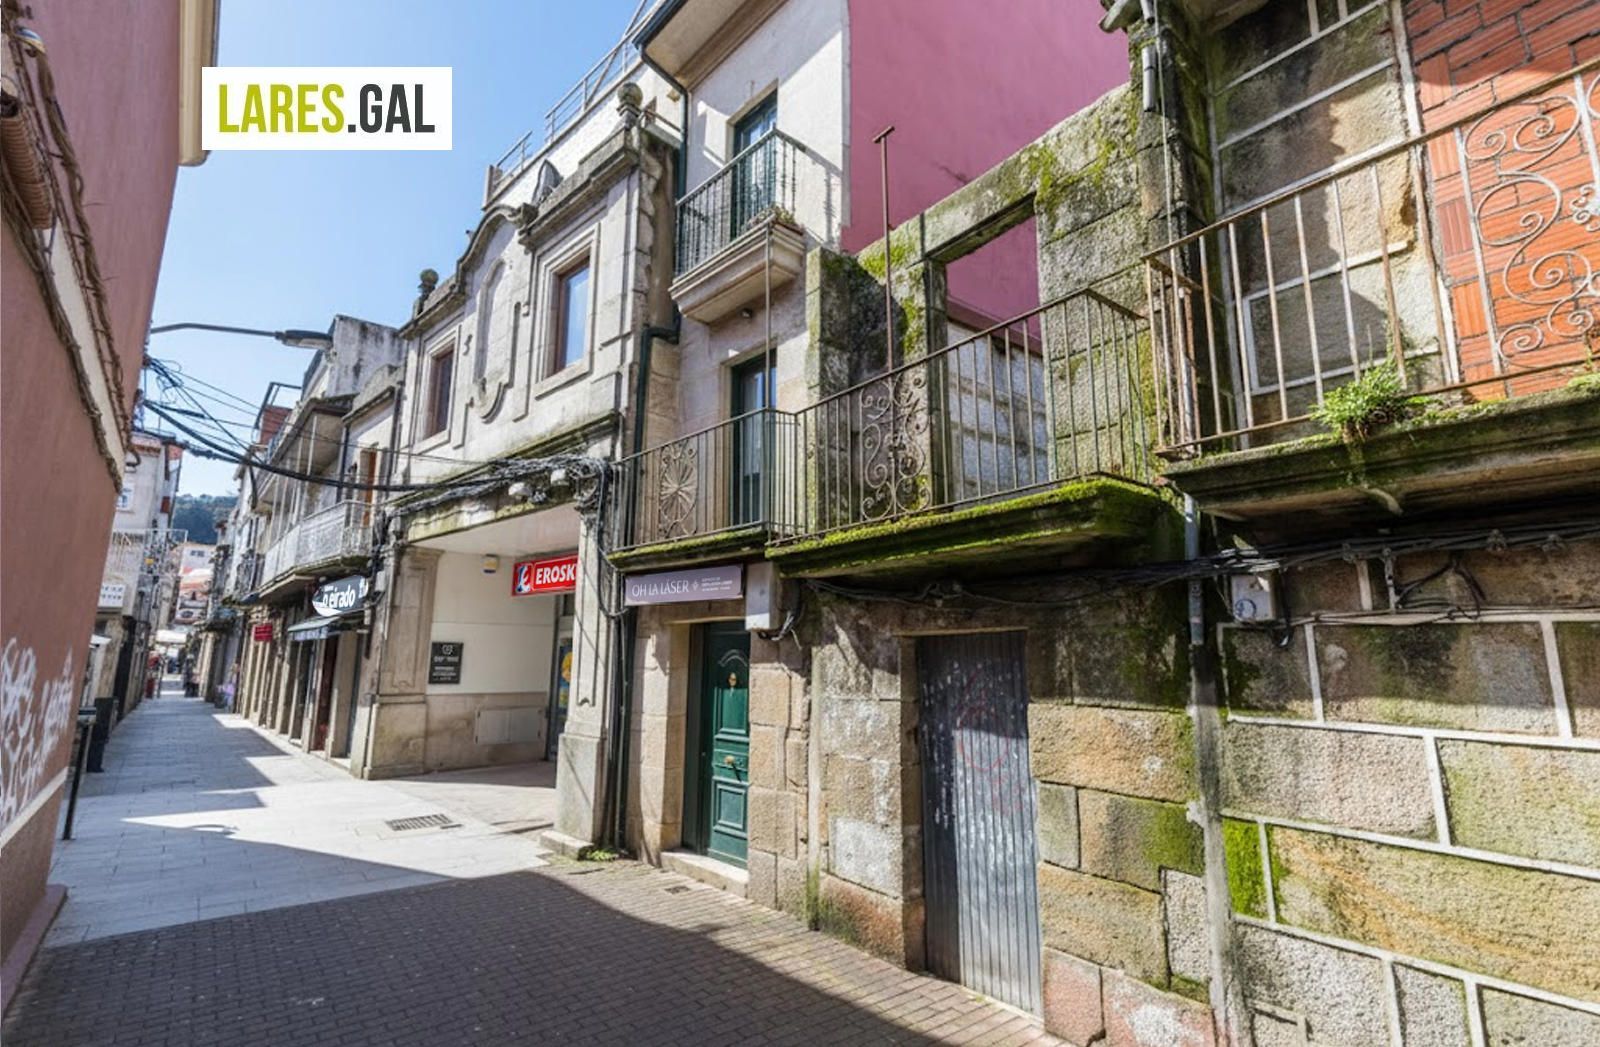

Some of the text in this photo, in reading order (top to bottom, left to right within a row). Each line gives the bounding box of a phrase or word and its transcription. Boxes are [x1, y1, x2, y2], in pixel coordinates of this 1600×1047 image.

[535, 563, 577, 585] EROSK
[631, 583, 647, 597] OH
[648, 583, 659, 596] LA
